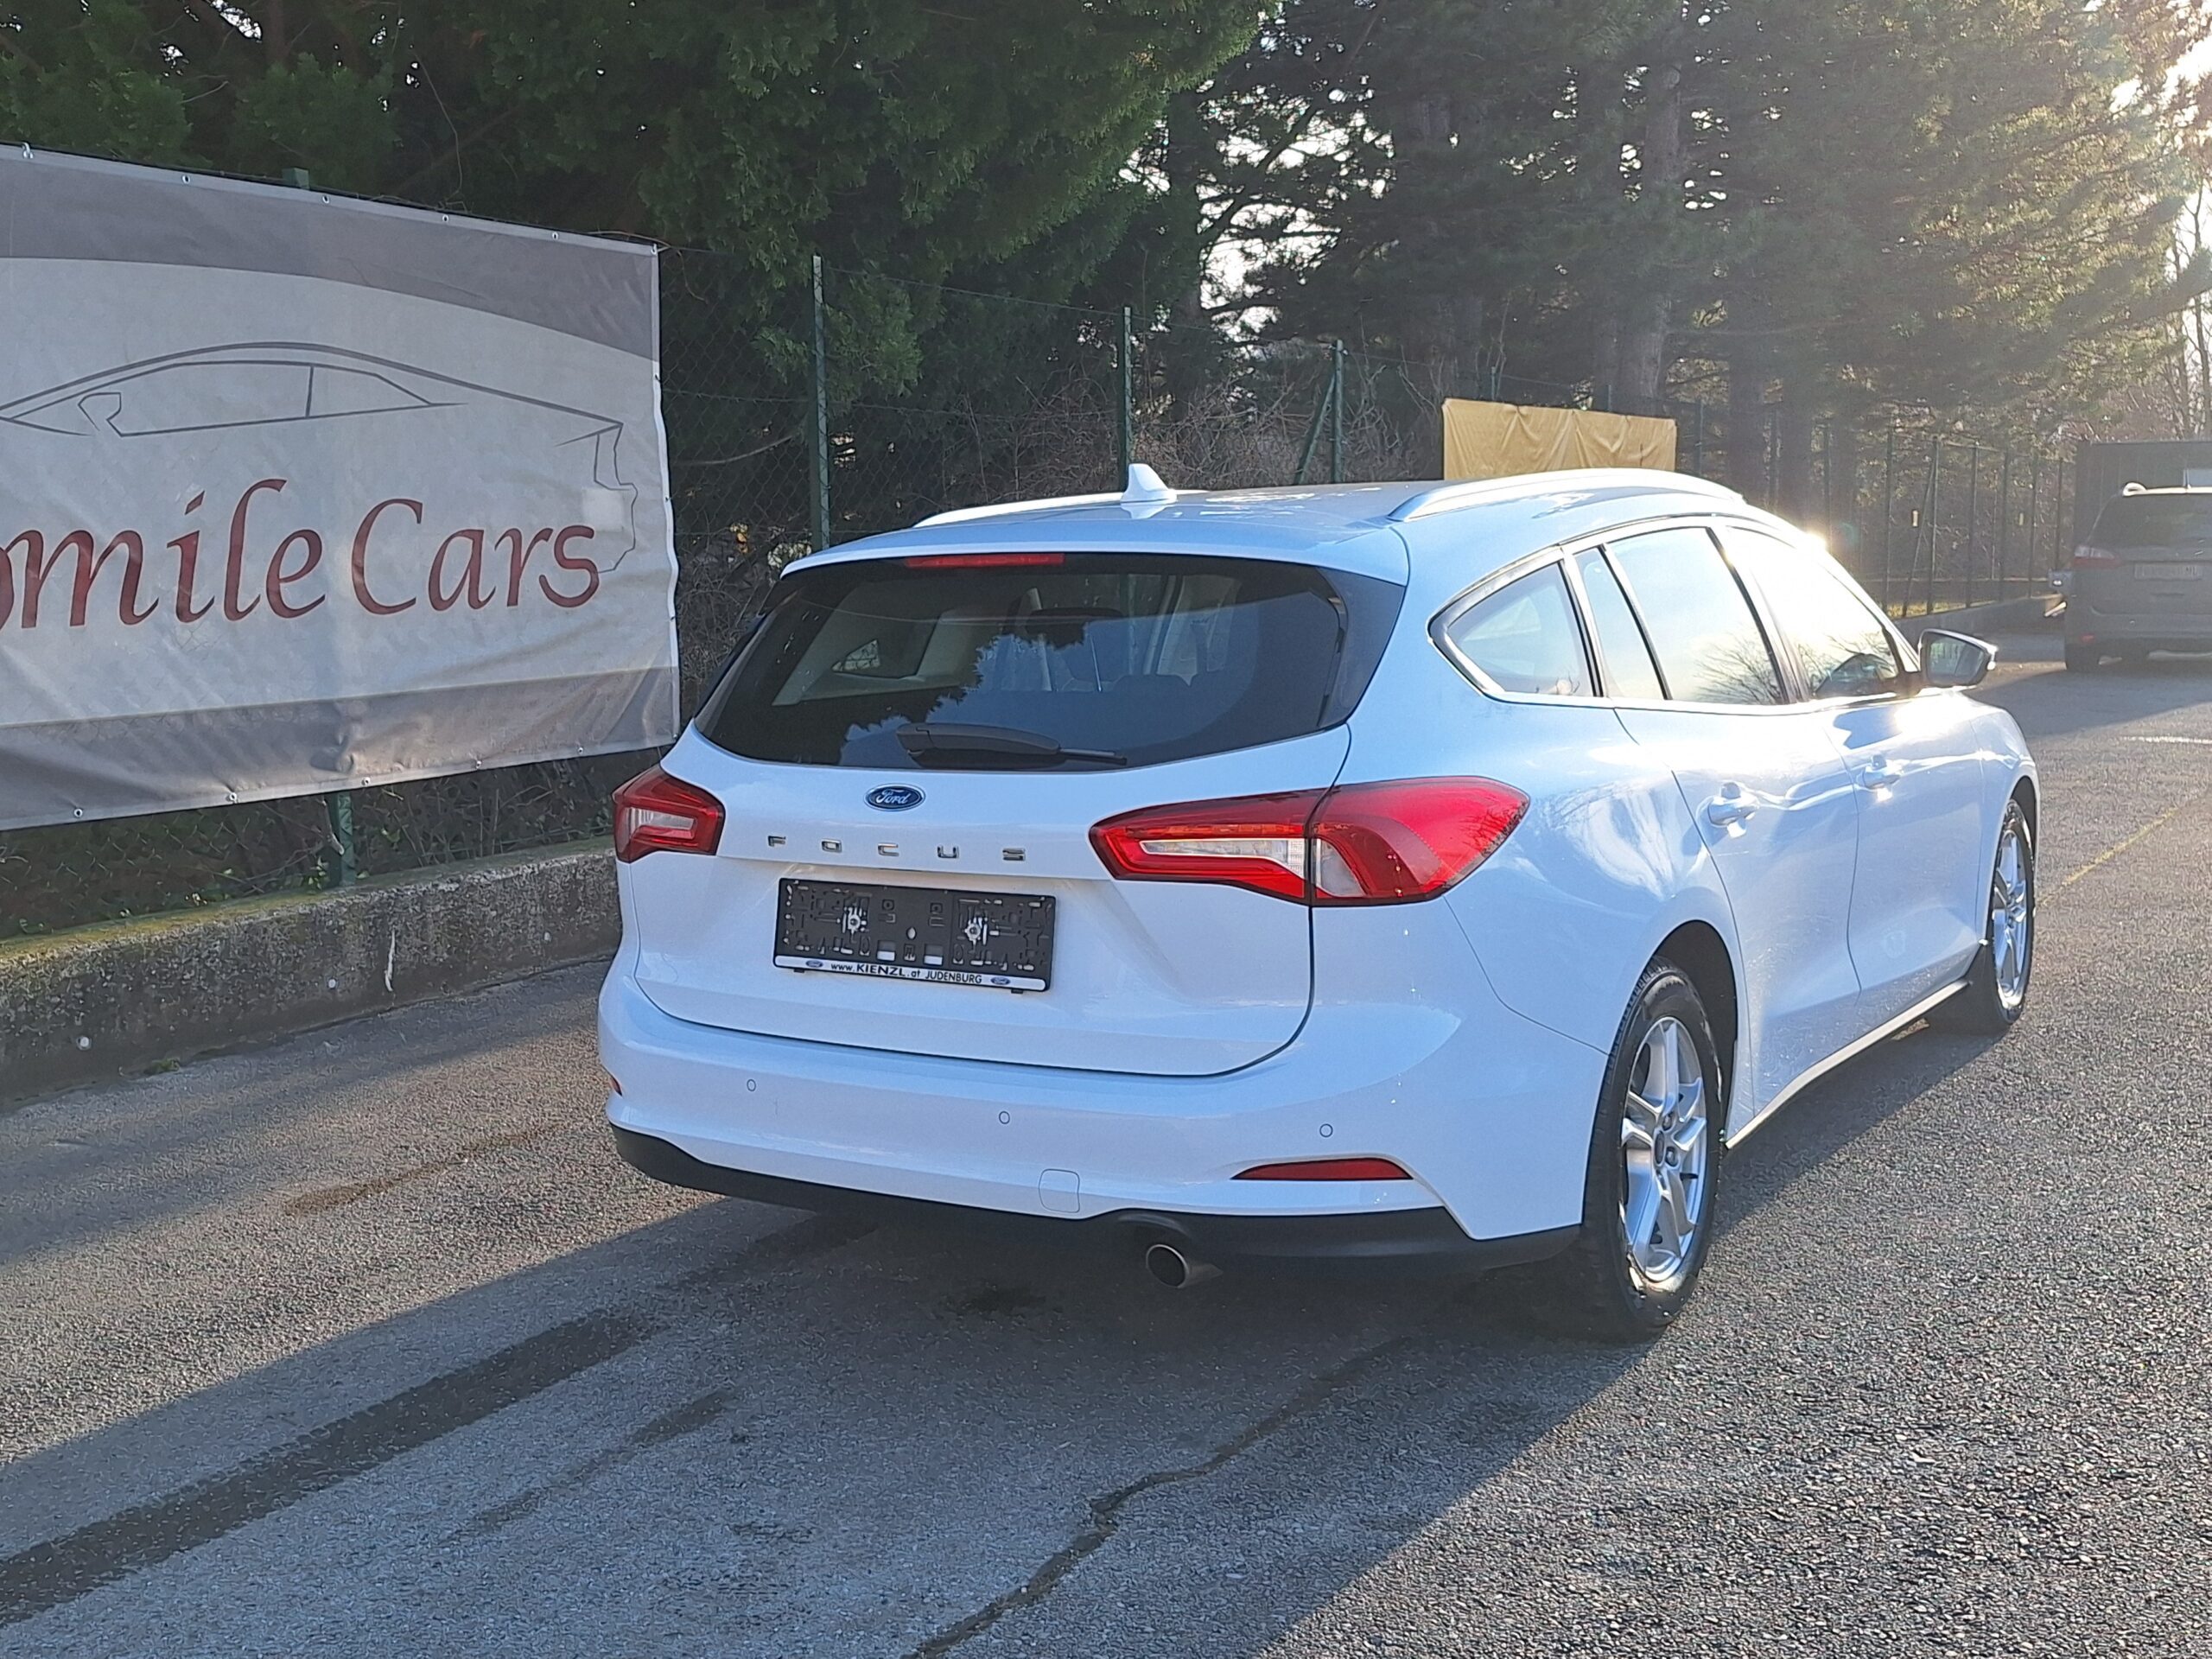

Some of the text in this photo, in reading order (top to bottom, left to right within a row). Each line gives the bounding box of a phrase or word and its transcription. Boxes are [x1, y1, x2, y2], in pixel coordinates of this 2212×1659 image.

[0, 479, 600, 631] mile Cars
[875, 788, 912, 804] Ford
[767, 835, 1026, 861] FOCUS
[925, 970, 982, 984] JUDENBURG
